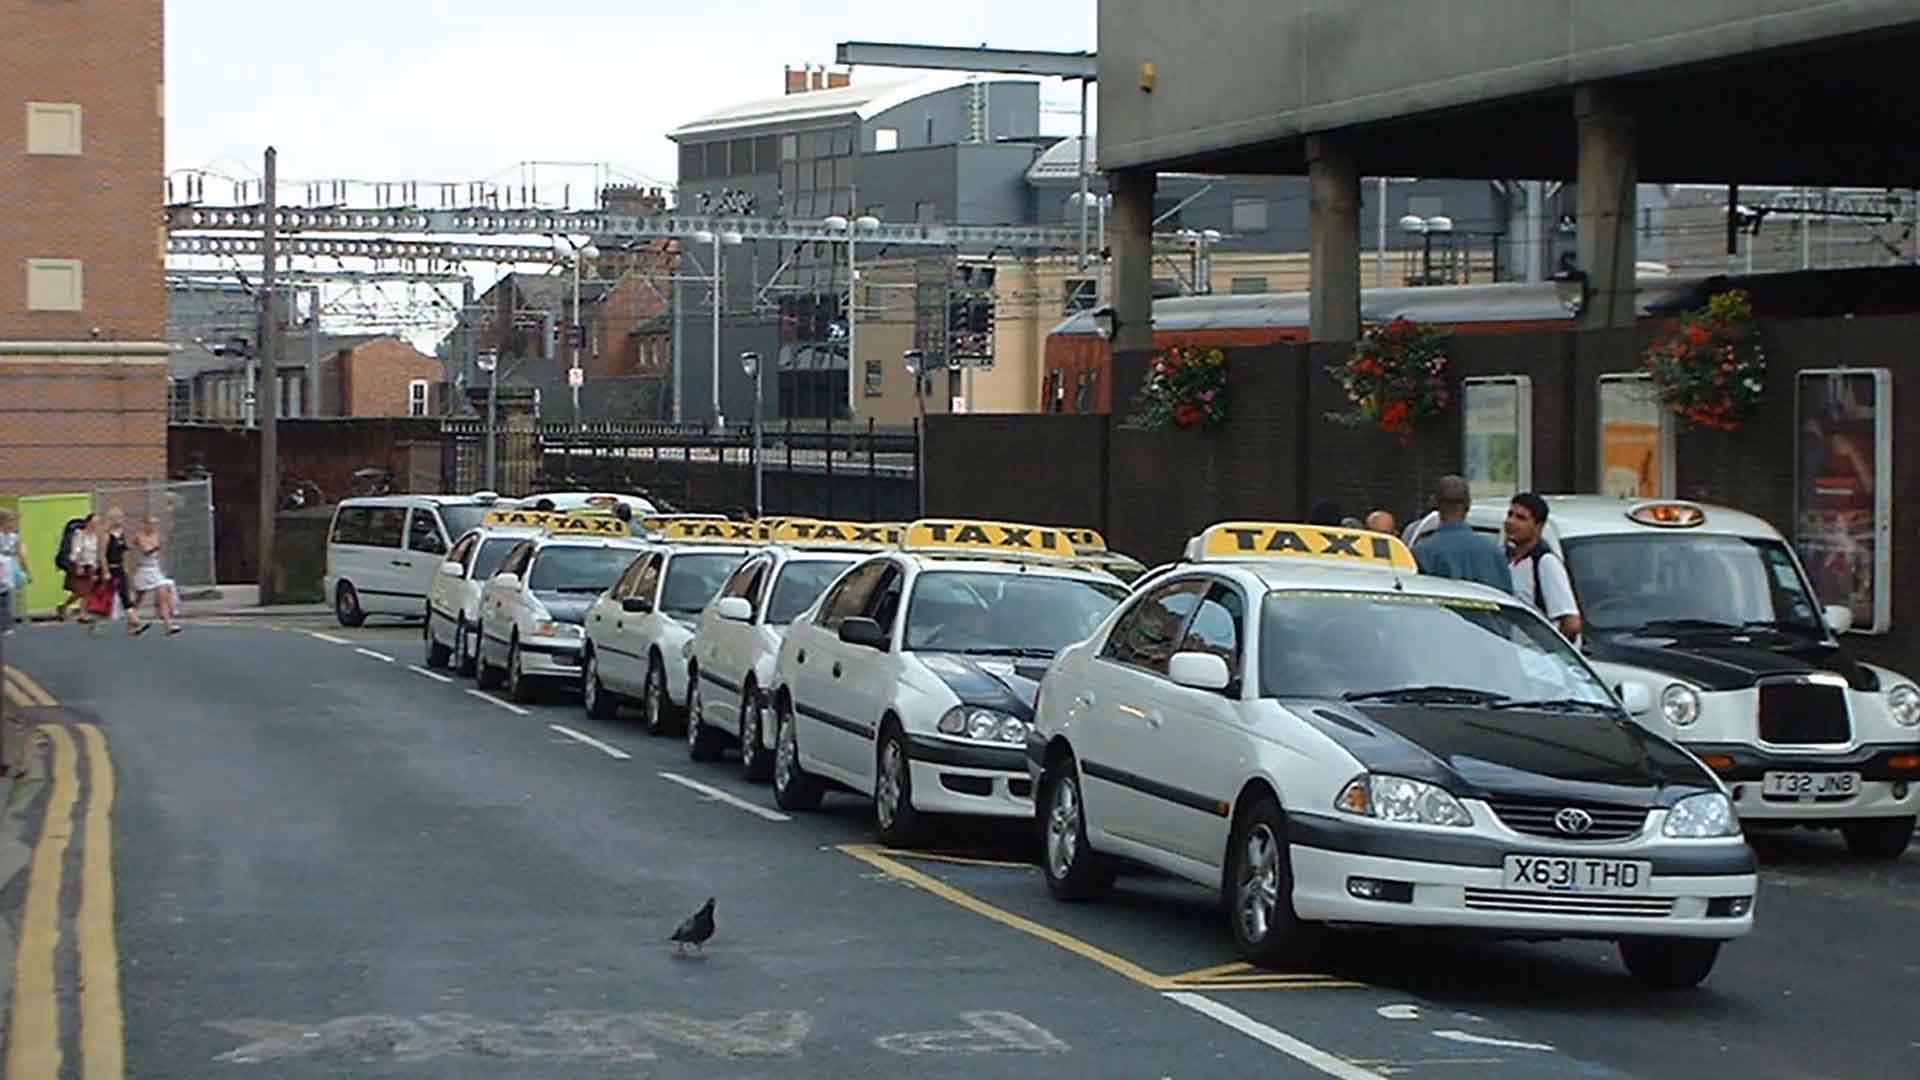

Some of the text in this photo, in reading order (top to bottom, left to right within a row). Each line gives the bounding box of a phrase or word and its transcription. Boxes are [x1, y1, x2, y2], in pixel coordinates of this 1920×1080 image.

[494, 511, 549, 527] TAX
[556, 517, 623, 532] TAXI
[680, 522, 770, 540] TAXI
[791, 523, 899, 544] TAXI
[923, 523, 1057, 549] TAXI
[1225, 528, 1391, 560] TAXI
[1774, 775, 1812, 792] T32
[1513, 858, 1638, 887] X631 THD
